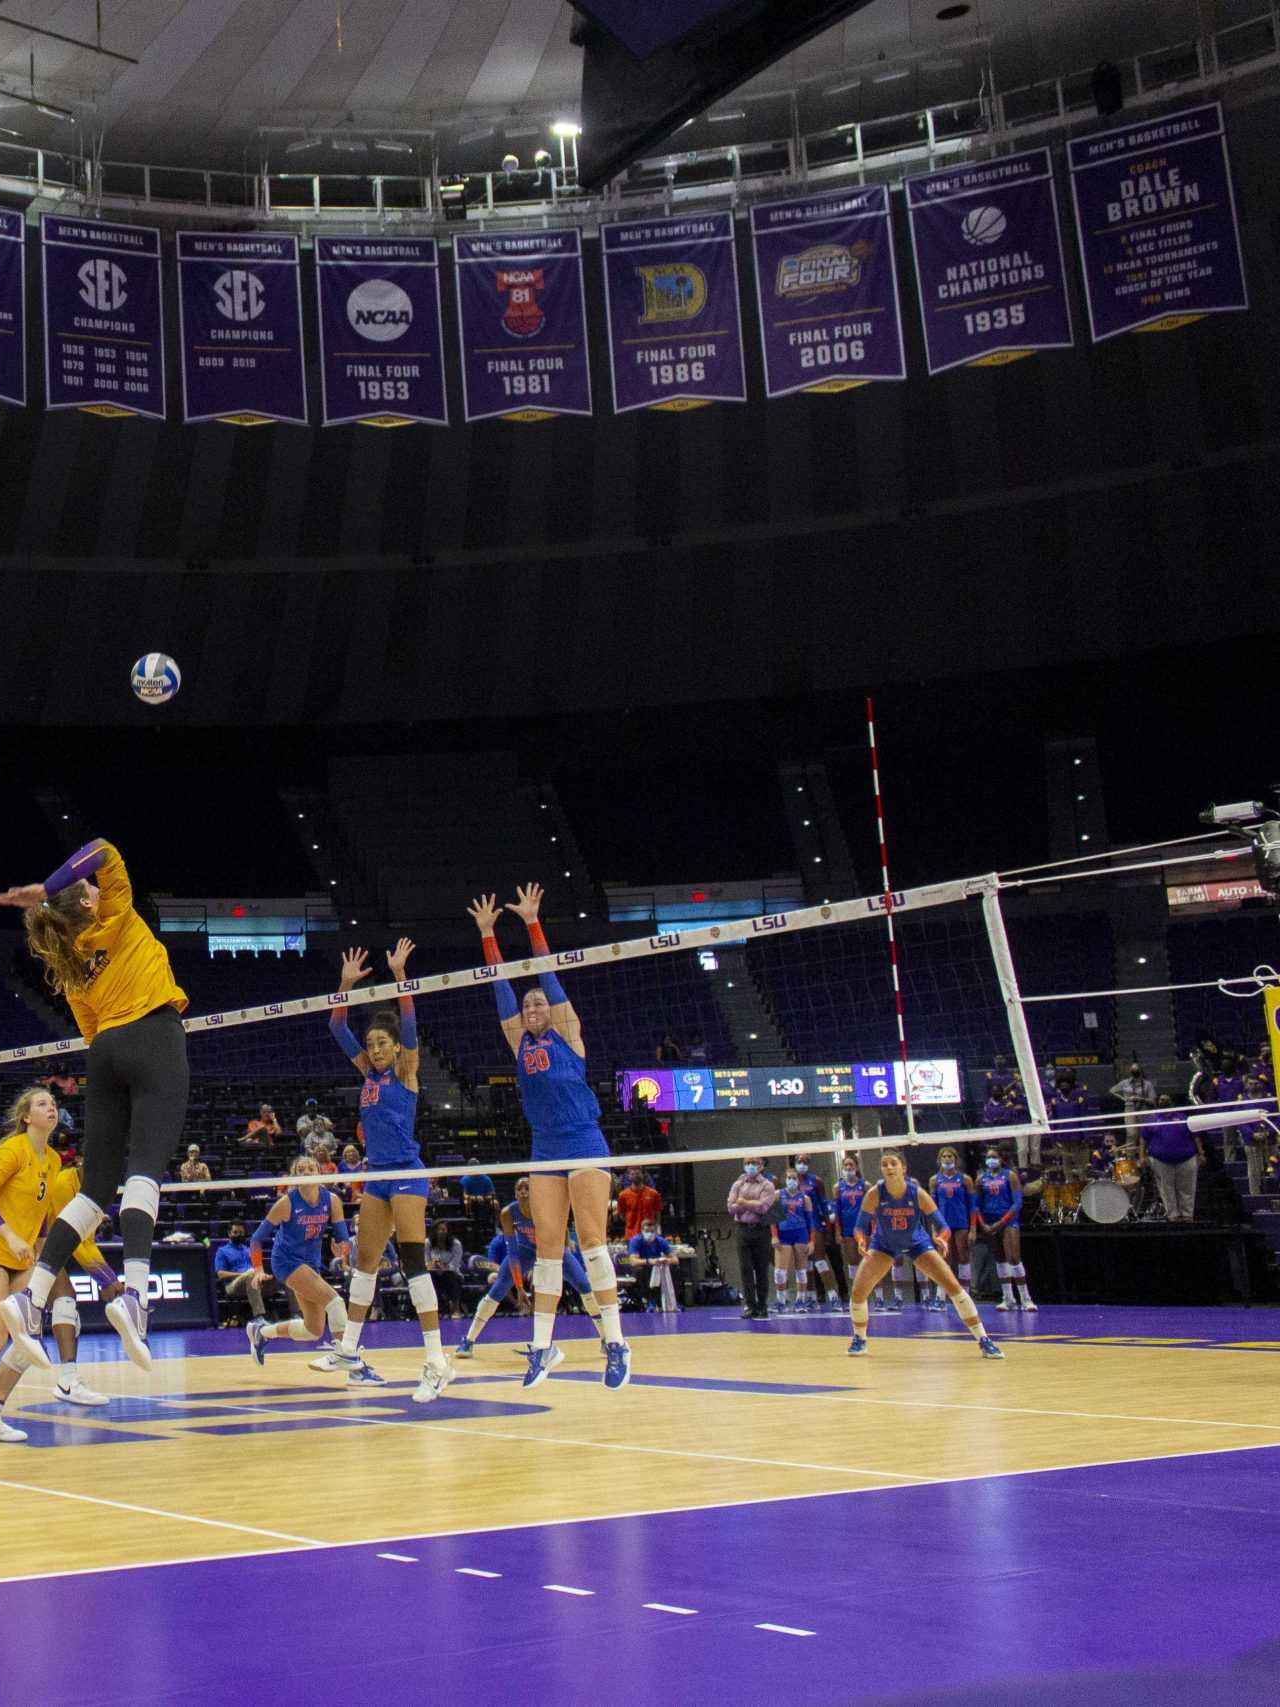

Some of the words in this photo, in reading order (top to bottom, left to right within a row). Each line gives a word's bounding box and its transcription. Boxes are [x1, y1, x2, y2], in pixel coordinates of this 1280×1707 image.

[1088, 137, 1125, 156] MEN'S
[1128, 119, 1200, 147] BASKETBALL
[926, 177, 960, 194] MEN'S
[963, 161, 1031, 186] BASKETBALL
[1120, 167, 1182, 200] DALE
[1106, 182, 1201, 223] BROWN
[58, 225, 87, 238] MEN'S
[89, 229, 144, 246] BASKETBALL
[620, 229, 651, 241] MEN'S
[654, 222, 715, 239] BASKETBALL
[194, 241, 224, 251] MEN'S
[227, 242, 283, 254] BASKETBALL
[368, 246, 420, 257] BASKETBALL
[505, 237, 563, 250] BASKETBALL
[1116, 258, 1143, 272] NCAA
[1145, 240, 1219, 265] TOURNAMENTS
[946, 251, 1033, 282] NATIONAL
[1150, 259, 1199, 278] NATIONAL
[77, 258, 128, 311] SEC
[503, 271, 535, 284] NCAA
[783, 266, 851, 288] FOUR
[938, 264, 1045, 299] CHAMPIONS
[1150, 277, 1164, 289] OF
[1166, 272, 1184, 286] THE
[1187, 266, 1213, 281] YEAR
[213, 270, 266, 321] SEC
[512, 288, 530, 303] 81
[1164, 287, 1191, 300] WINS
[73, 317, 135, 333] CHAMPIONS
[355, 310, 411, 325] NCAA
[963, 304, 1026, 335] 1935
[210, 328, 274, 341] CHAMPIONS
[789, 329, 830, 345] FINAL
[834, 322, 872, 339] FOUR
[636, 348, 675, 364] FINAL
[680, 343, 717, 359] FOUR
[800, 340, 865, 368] 2006
[346, 364, 382, 377] FINAL
[386, 365, 420, 377] FOUR
[487, 359, 525, 374] FINAL
[529, 357, 564, 371] FOUR
[649, 361, 705, 385] 1986
[358, 381, 410, 401] 1953
[502, 374, 551, 395] 1981
[1217, 887, 1247, 897] AUTO
[752, 914, 786, 932] LSU
[649, 933, 681, 950] LSU
[556, 950, 585, 966] LSU
[473, 966, 497, 980] LSU
[397, 980, 420, 993] LSU
[327, 992, 349, 1005] LSU
[264, 1004, 283, 1016] LSU
[205, 1014, 224, 1026] LSU
[13, 1048, 26, 1058] LSU
[56, 1040, 70, 1050] LSU
[525, 1048, 550, 1075] 20
[831, 1075, 839, 1085] 2
[862, 1066, 886, 1077] LSU
[729, 1078, 735, 1088] 1
[768, 1078, 804, 1095] 1:30
[873, 1080, 888, 1098] 6
[690, 1086, 703, 1103] 7
[729, 1097, 737, 1106] 2
[832, 1093, 840, 1104] 2
[37, 1181, 46, 1202] 3
